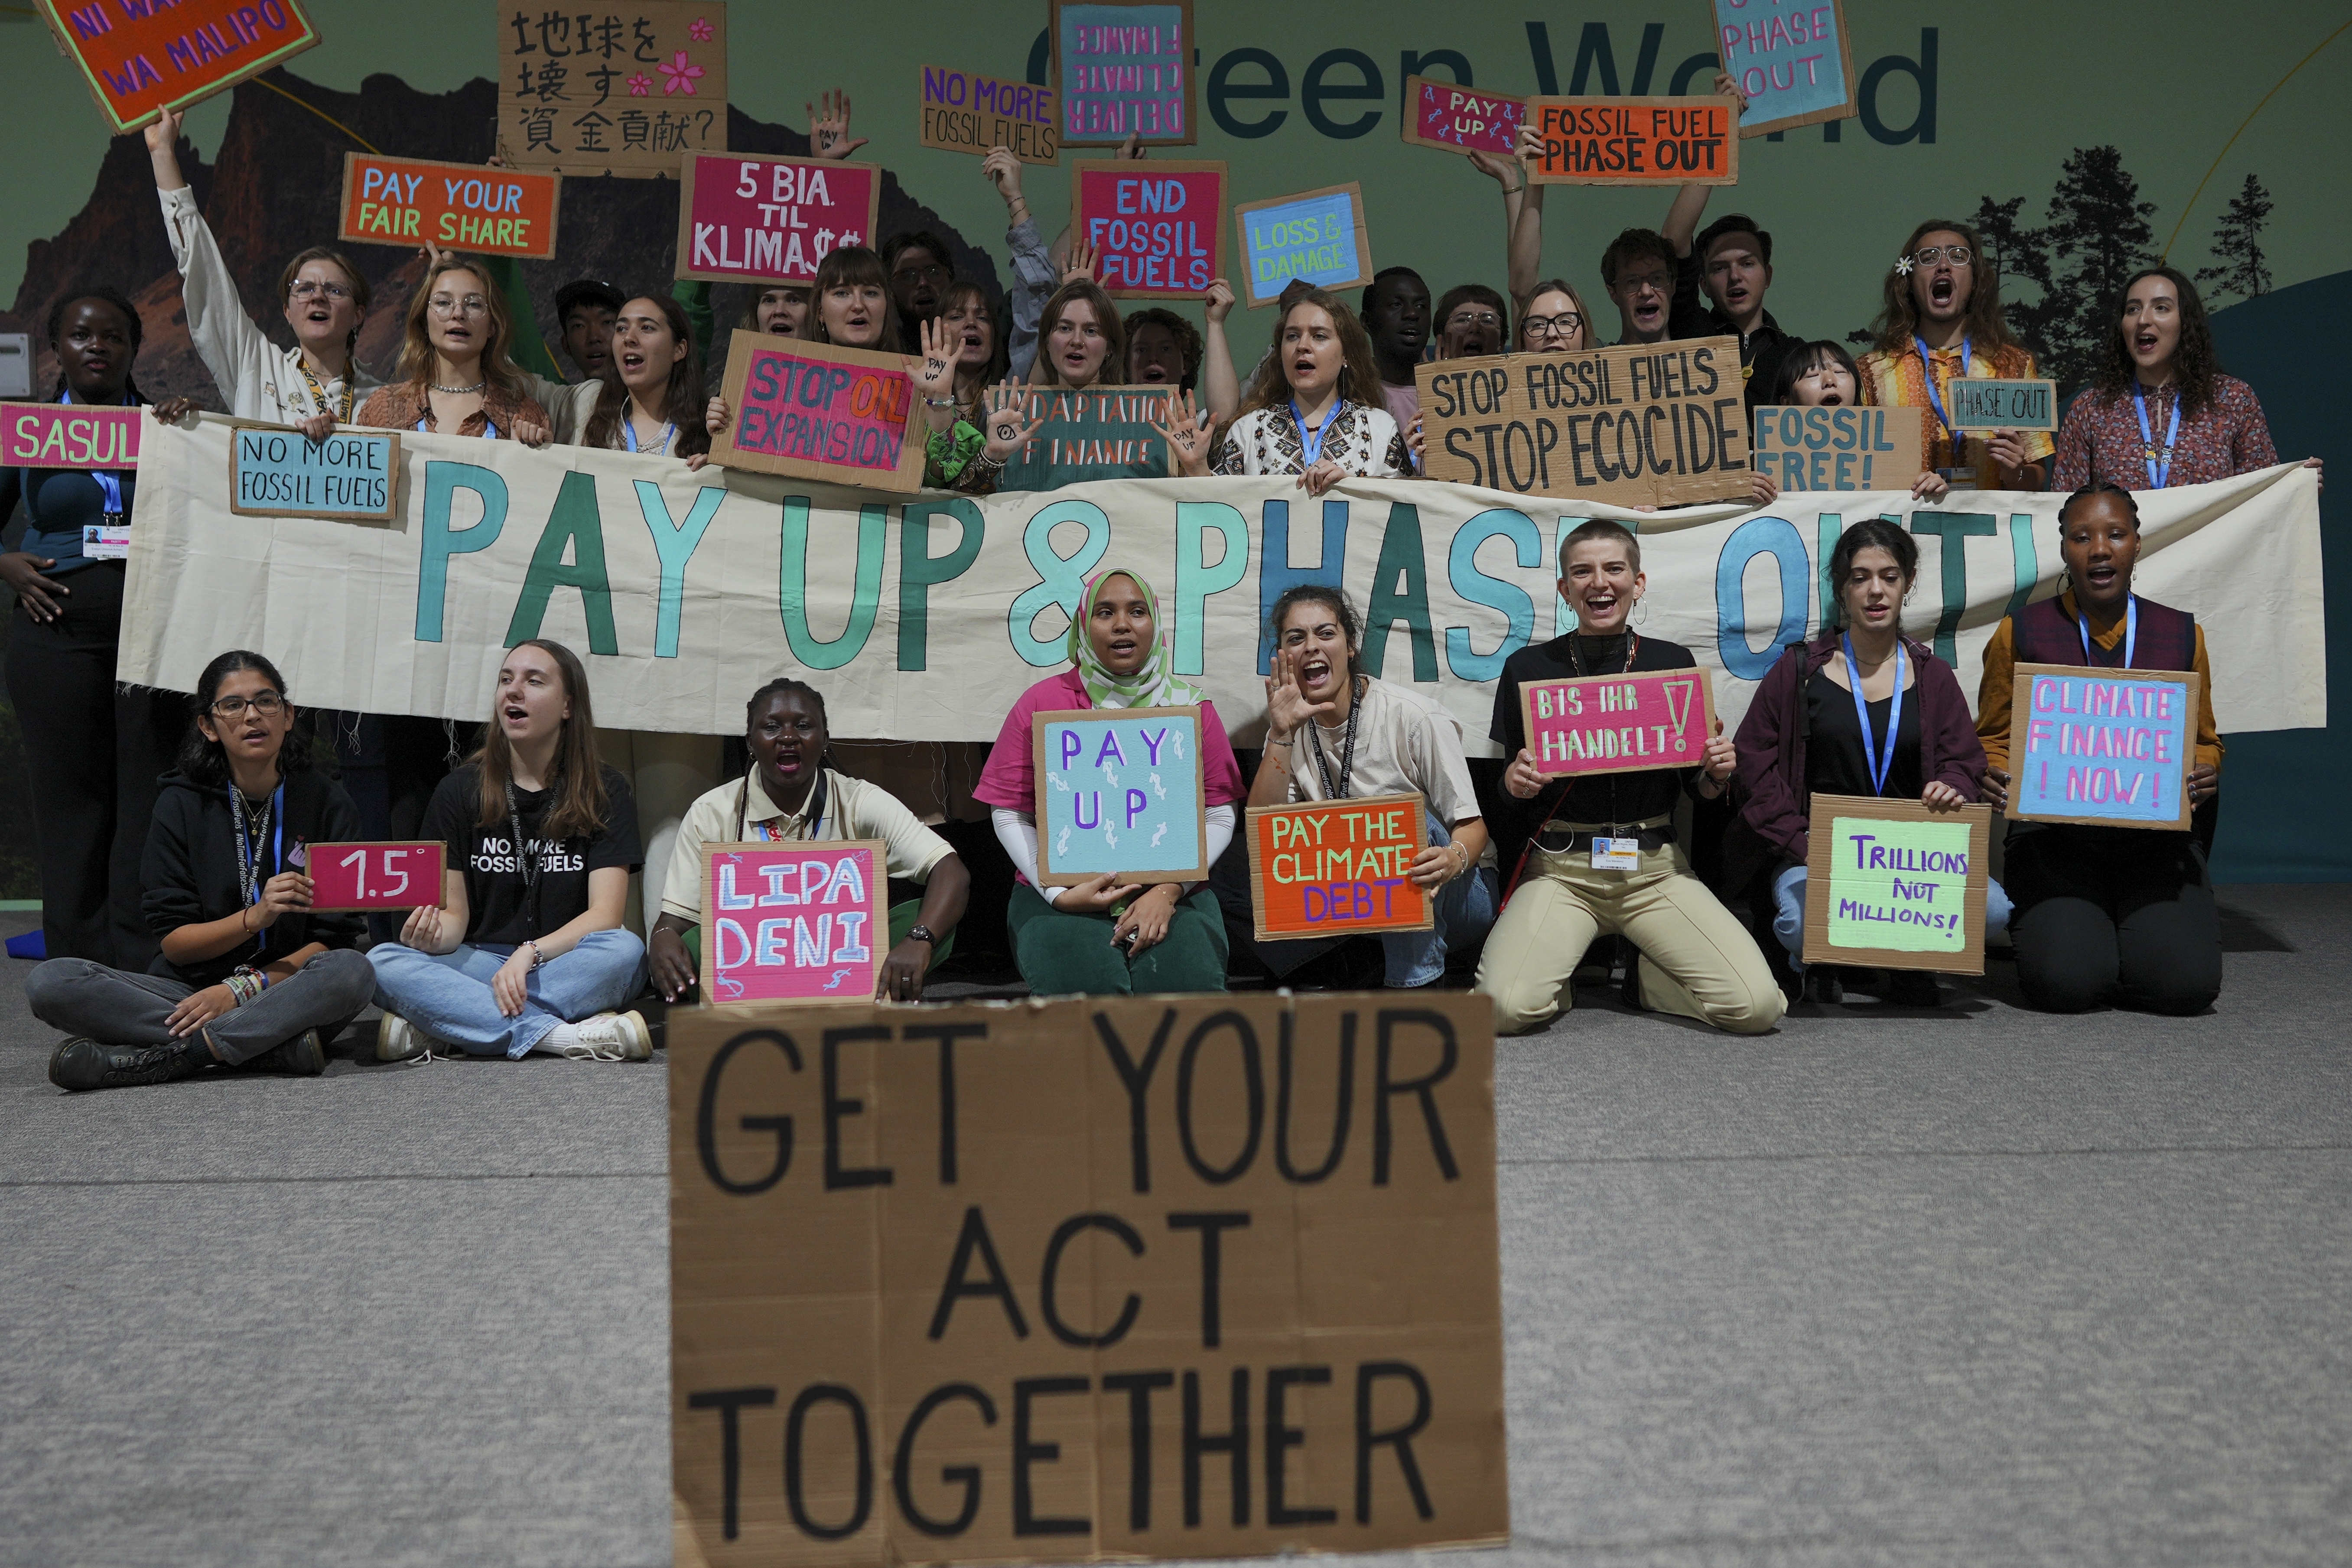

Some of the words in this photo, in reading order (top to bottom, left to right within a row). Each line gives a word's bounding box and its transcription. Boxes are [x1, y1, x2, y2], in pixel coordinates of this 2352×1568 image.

[70, 2, 112, 40] NI
[511, 11, 660, 62] 地球を
[1074, 24, 1181, 55] FINANCE
[1722, 6, 1830, 59] PHASE
[102, 54, 163, 97] WA
[165, 0, 286, 73] MALIPO
[517, 59, 623, 107] 壊す
[924, 67, 966, 106] NO
[974, 78, 1053, 124] MORE
[1073, 63, 1183, 94] CLIMATE
[1743, 54, 1823, 98] OUT
[1067, 98, 1183, 135] DELIVER
[1450, 92, 1497, 117] PAY
[1543, 107, 1640, 137] FOSSIL
[1652, 108, 1726, 137] FUEL
[819, 130, 837, 144] PAY
[924, 107, 989, 148] FOSSIL
[995, 118, 1055, 160] FUELS
[1454, 116, 1485, 136] UP
[1544, 137, 1646, 172] PHASE
[1654, 139, 1722, 172] OUT
[363, 168, 423, 205] PAY
[445, 178, 522, 214] YOUR
[736, 162, 760, 198] 5
[772, 165, 835, 207] BIA.
[1116, 179, 1186, 214] END
[358, 203, 420, 237] FAIR
[439, 213, 530, 247] SHARE
[757, 203, 808, 229] TIL
[1255, 218, 1319, 251] LOSS
[1325, 213, 1341, 241] &
[1090, 217, 1207, 257] FOSSIL
[1103, 254, 1209, 290] FUELS
[1258, 243, 1346, 283] DAMAGE
[925, 372, 938, 381] UP
[928, 358, 946, 373] PAY
[1432, 368, 1509, 418] STOP
[1629, 348, 1718, 401] FUELS
[751, 357, 851, 411] STOP
[850, 374, 906, 423] OIL
[1018, 393, 1173, 423] DAPTATION
[1956, 388, 2004, 419] PHASE
[2013, 389, 2049, 419] OUT
[738, 407, 903, 468] EXPANSION
[1173, 428, 1194, 441] PAY
[1445, 418, 1558, 491] STOP
[1568, 397, 1745, 486] ECOCIDE
[1756, 407, 1894, 451] FOSSIL
[243, 435, 286, 462] NO
[303, 435, 382, 471] MORE
[1022, 438, 1153, 465] FINANCE
[1757, 451, 1872, 491] FREE!
[242, 471, 315, 504] FOSSIL
[325, 475, 386, 508] FUELS
[415, 461, 728, 657] PAY
[780, 495, 985, 671] UP
[1008, 500, 1110, 667] &
[1172, 500, 1639, 682] PHAS
[1537, 686, 1583, 719] BIS
[1599, 684, 1638, 712] IHR
[2035, 679, 2175, 720] CLIMATE
[1062, 728, 1169, 770] PAY
[1343, 707, 1358, 778] #NoTimeForFalseSolutions
[2029, 720, 2171, 763] FINANCE
[2066, 766, 2144, 805] NOW
[1075, 789, 1147, 830] UP
[483, 838, 511, 854] NO
[1272, 814, 1330, 849] PAY
[1340, 811, 1406, 843] THE
[718, 857, 865, 910] LIPA
[1272, 844, 1414, 884] CLIMATE
[1303, 878, 1404, 922] DEBT
[1893, 878, 1940, 903] NOT
[1839, 898, 1958, 938] MILLIONS!
[716, 911, 869, 969] DENI
[696, 1022, 988, 1195] GET
[1092, 1008, 1459, 1194] YOUR
[927, 1205, 1252, 1349] ACT
[687, 1360, 1435, 1542] TOGETHER
